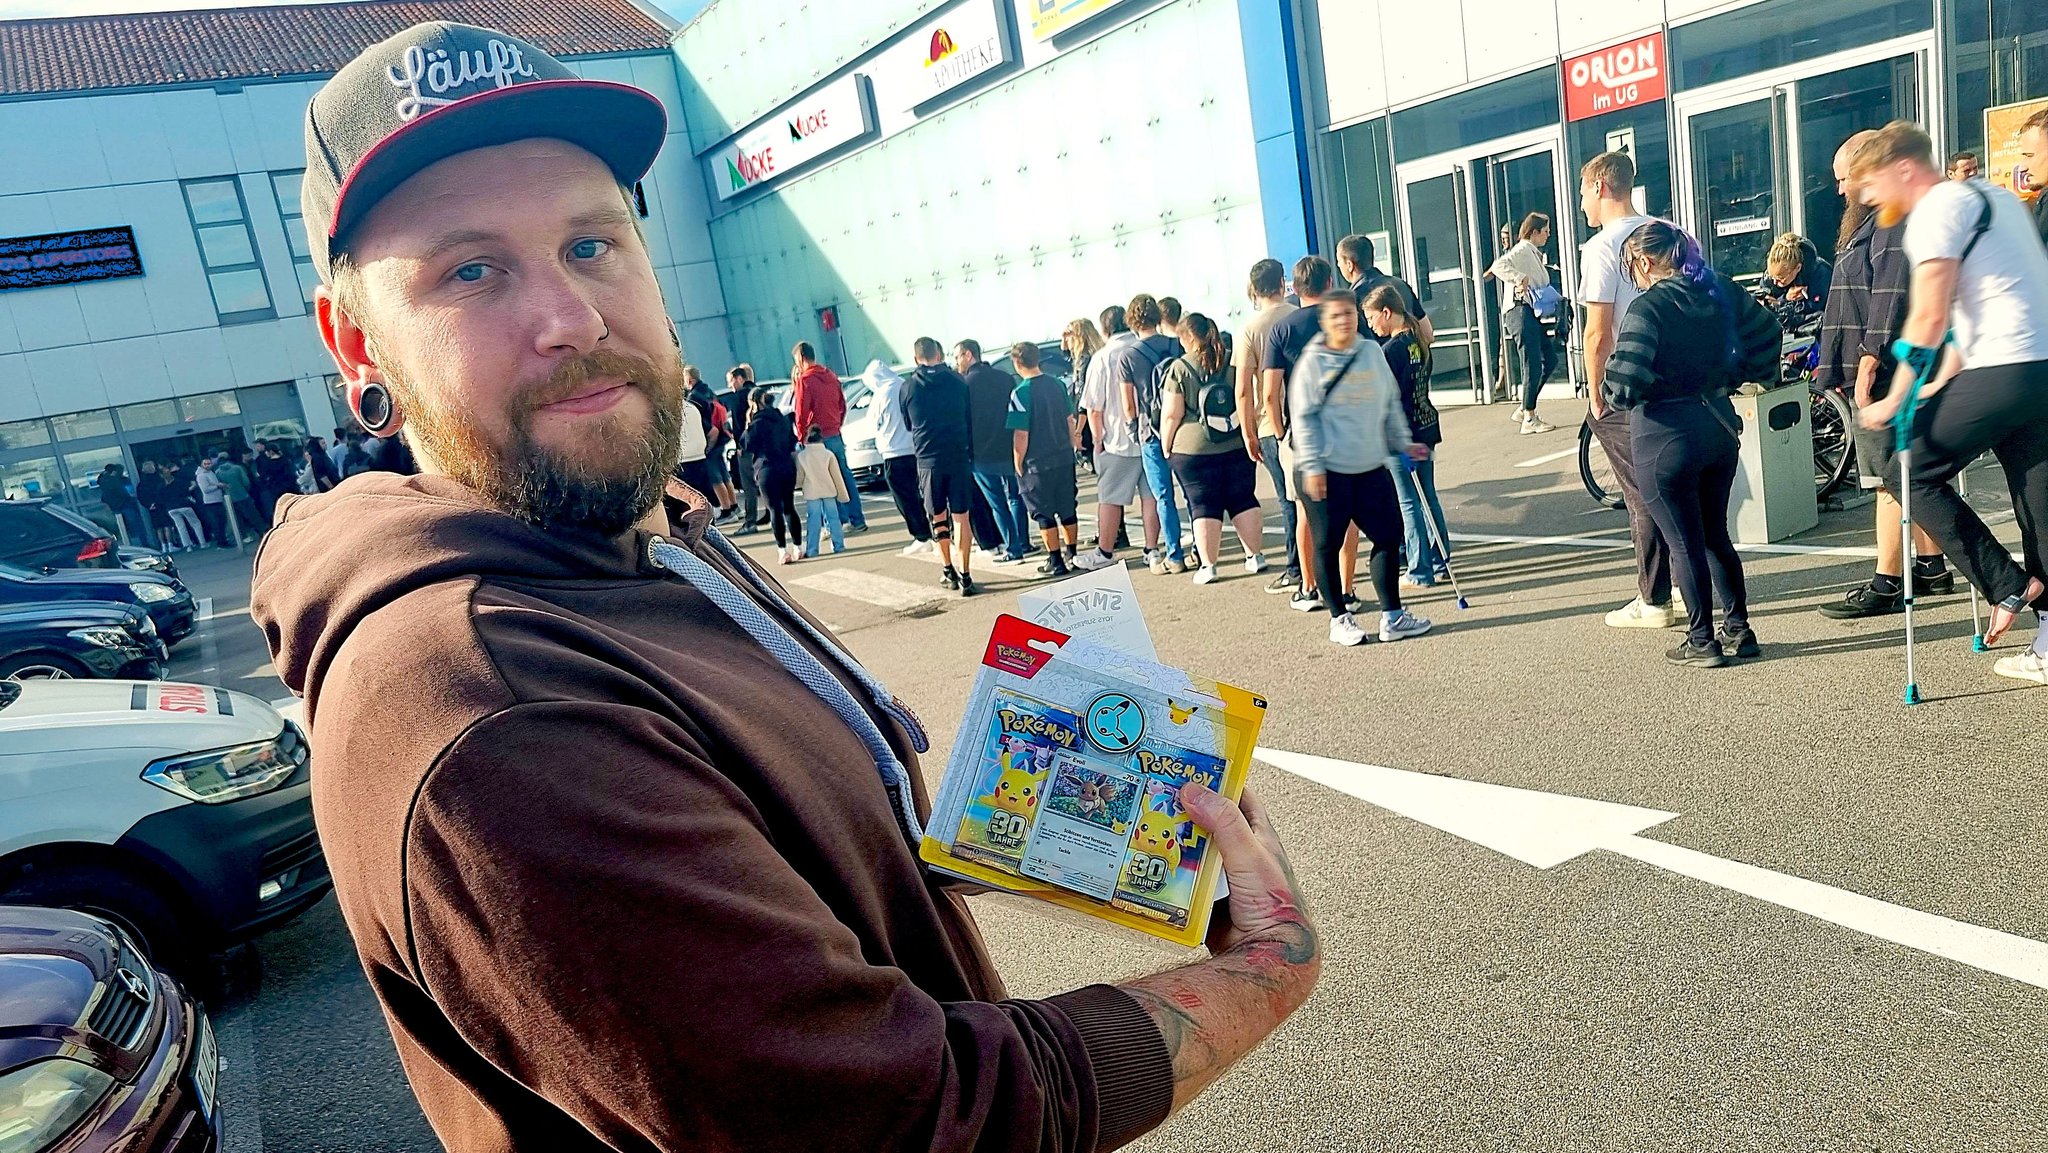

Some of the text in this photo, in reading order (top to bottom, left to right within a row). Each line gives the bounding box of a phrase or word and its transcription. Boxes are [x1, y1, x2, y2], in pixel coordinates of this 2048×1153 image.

[934, 38, 996, 88] APOTHEKE
[1571, 40, 1658, 88] ORION
[388, 40, 534, 120] Läuft
[1615, 84, 1638, 105] UG
[998, 709, 1077, 748] Pokémon
[1138, 751, 1215, 787] Pokémon
[991, 811, 1026, 839] 30
[991, 834, 1019, 848] JAHRE
[1131, 852, 1165, 881] 30
[1131, 876, 1158, 890] JAHRE
